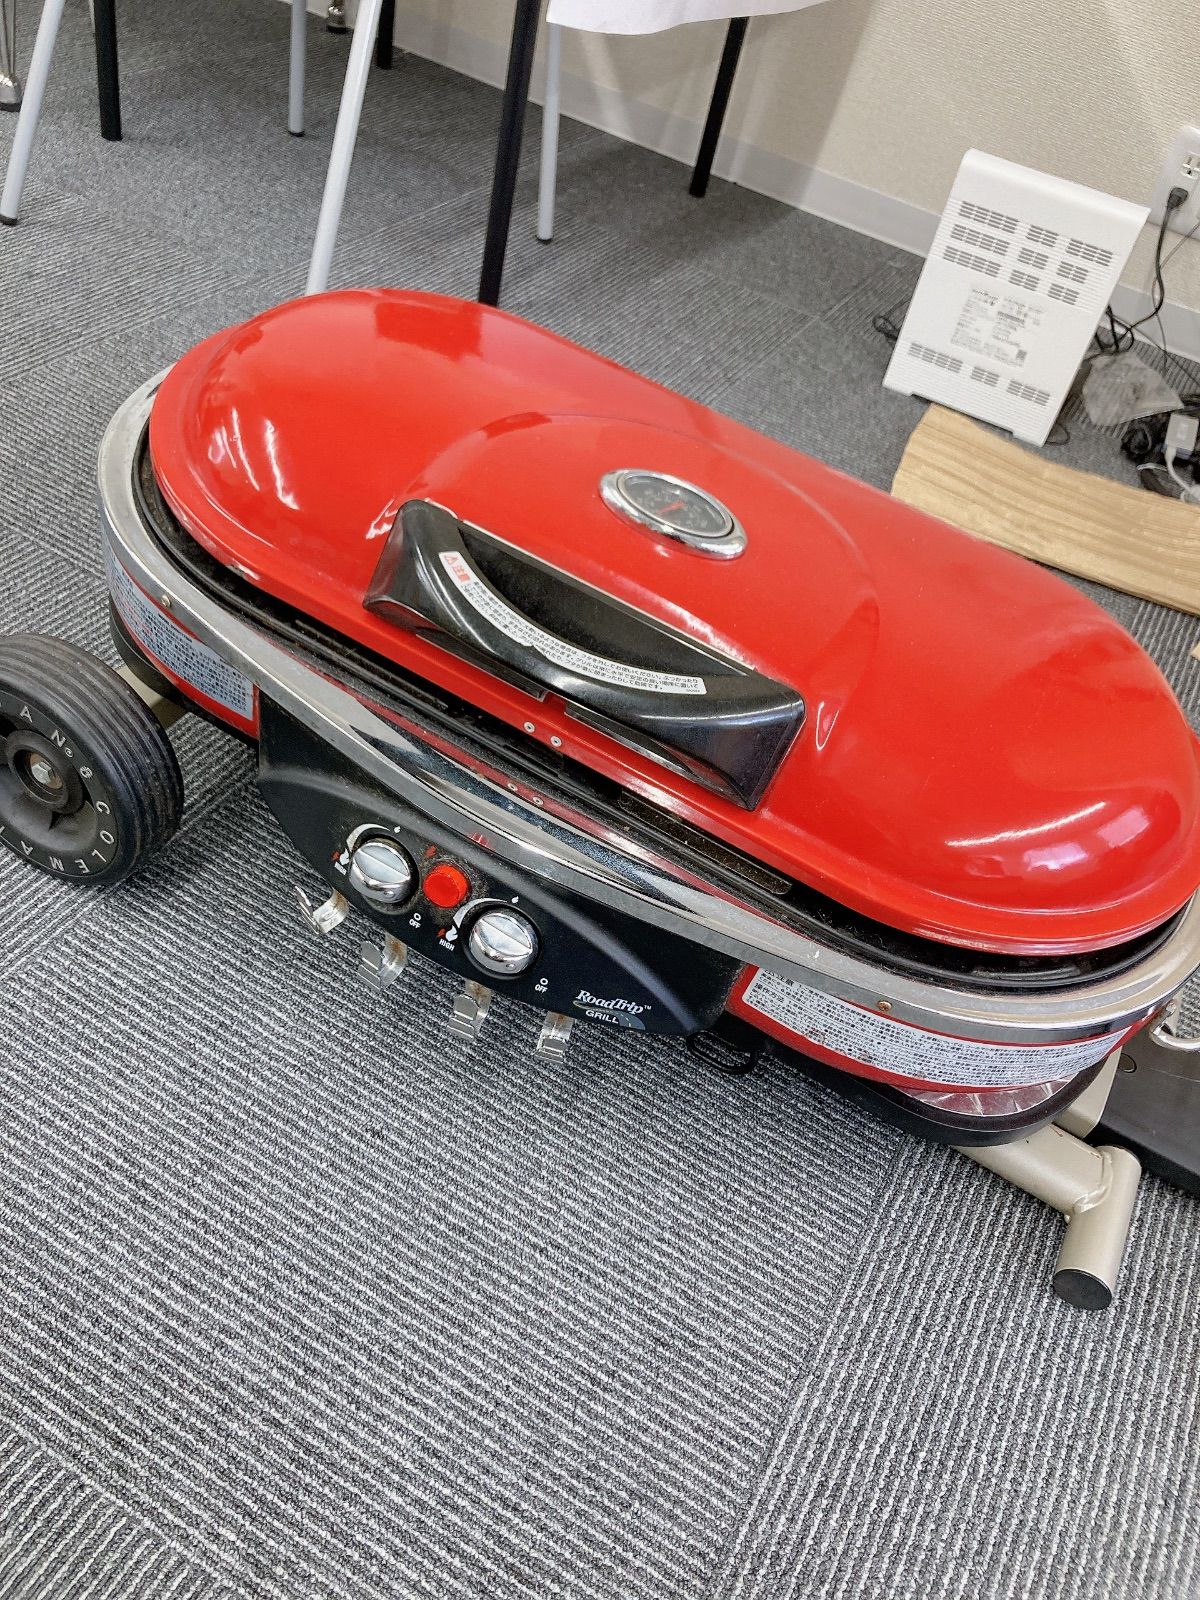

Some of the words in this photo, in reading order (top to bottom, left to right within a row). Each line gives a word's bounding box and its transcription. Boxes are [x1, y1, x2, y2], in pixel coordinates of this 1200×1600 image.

[409, 919, 421, 929] OFF
[439, 938, 455, 952] HIGH
[534, 983, 548, 993] OFF
[585, 1009, 619, 1024] GRILL
